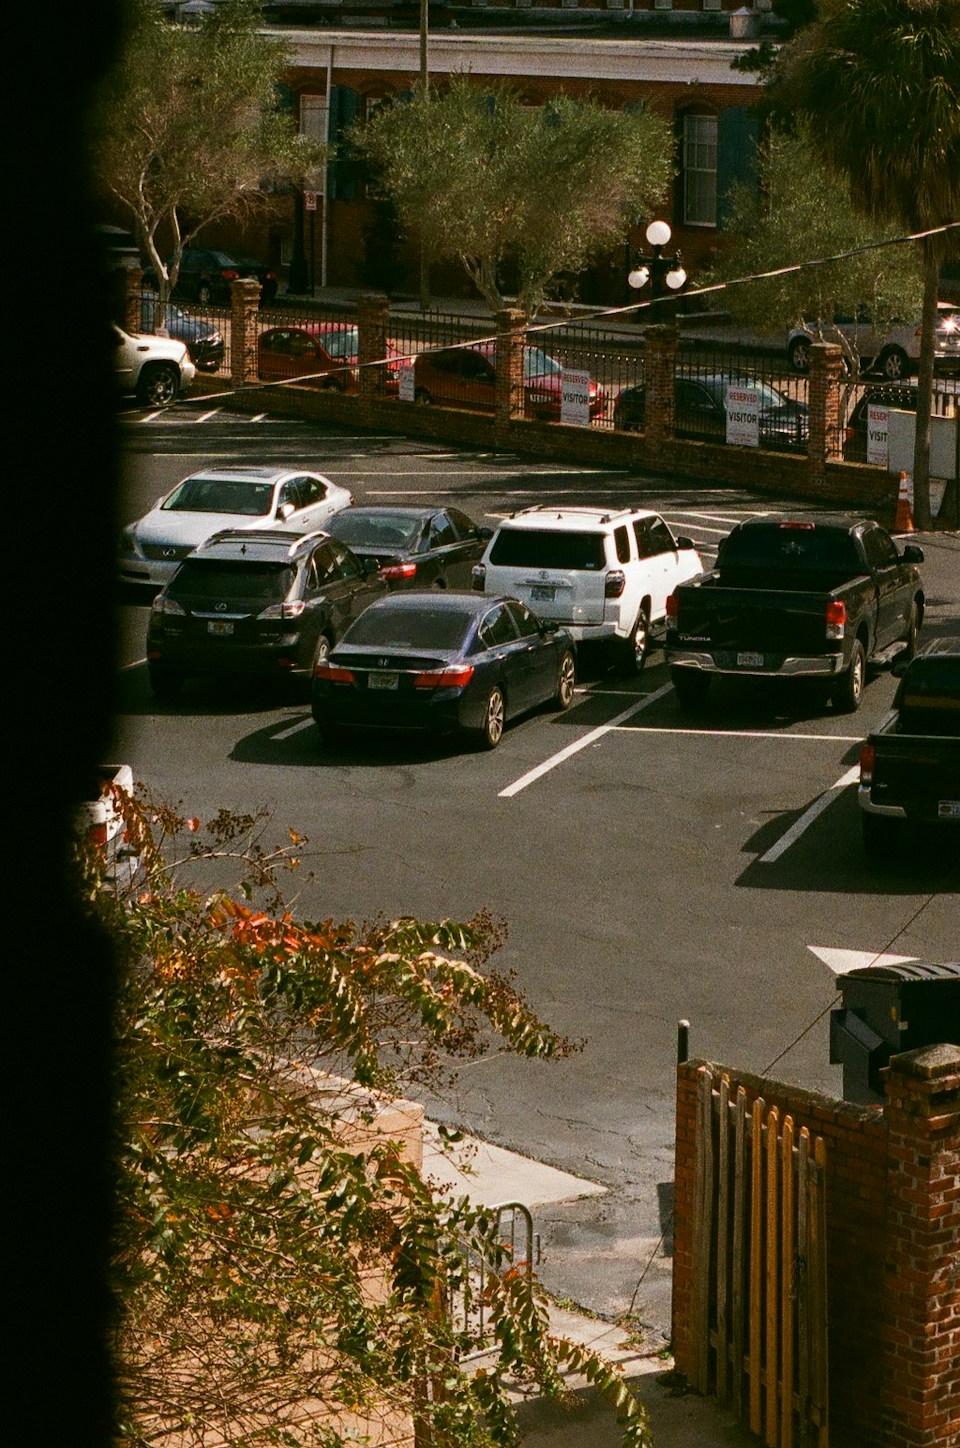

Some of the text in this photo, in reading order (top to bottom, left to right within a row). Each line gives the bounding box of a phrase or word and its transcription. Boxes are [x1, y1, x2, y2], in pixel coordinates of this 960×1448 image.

[563, 392, 588, 404] VISITOR
[729, 391, 757, 403] RESERVED
[729, 411, 757, 424] VISITOR
[869, 411, 888, 422] RESER
[869, 431, 888, 442] VISIT
